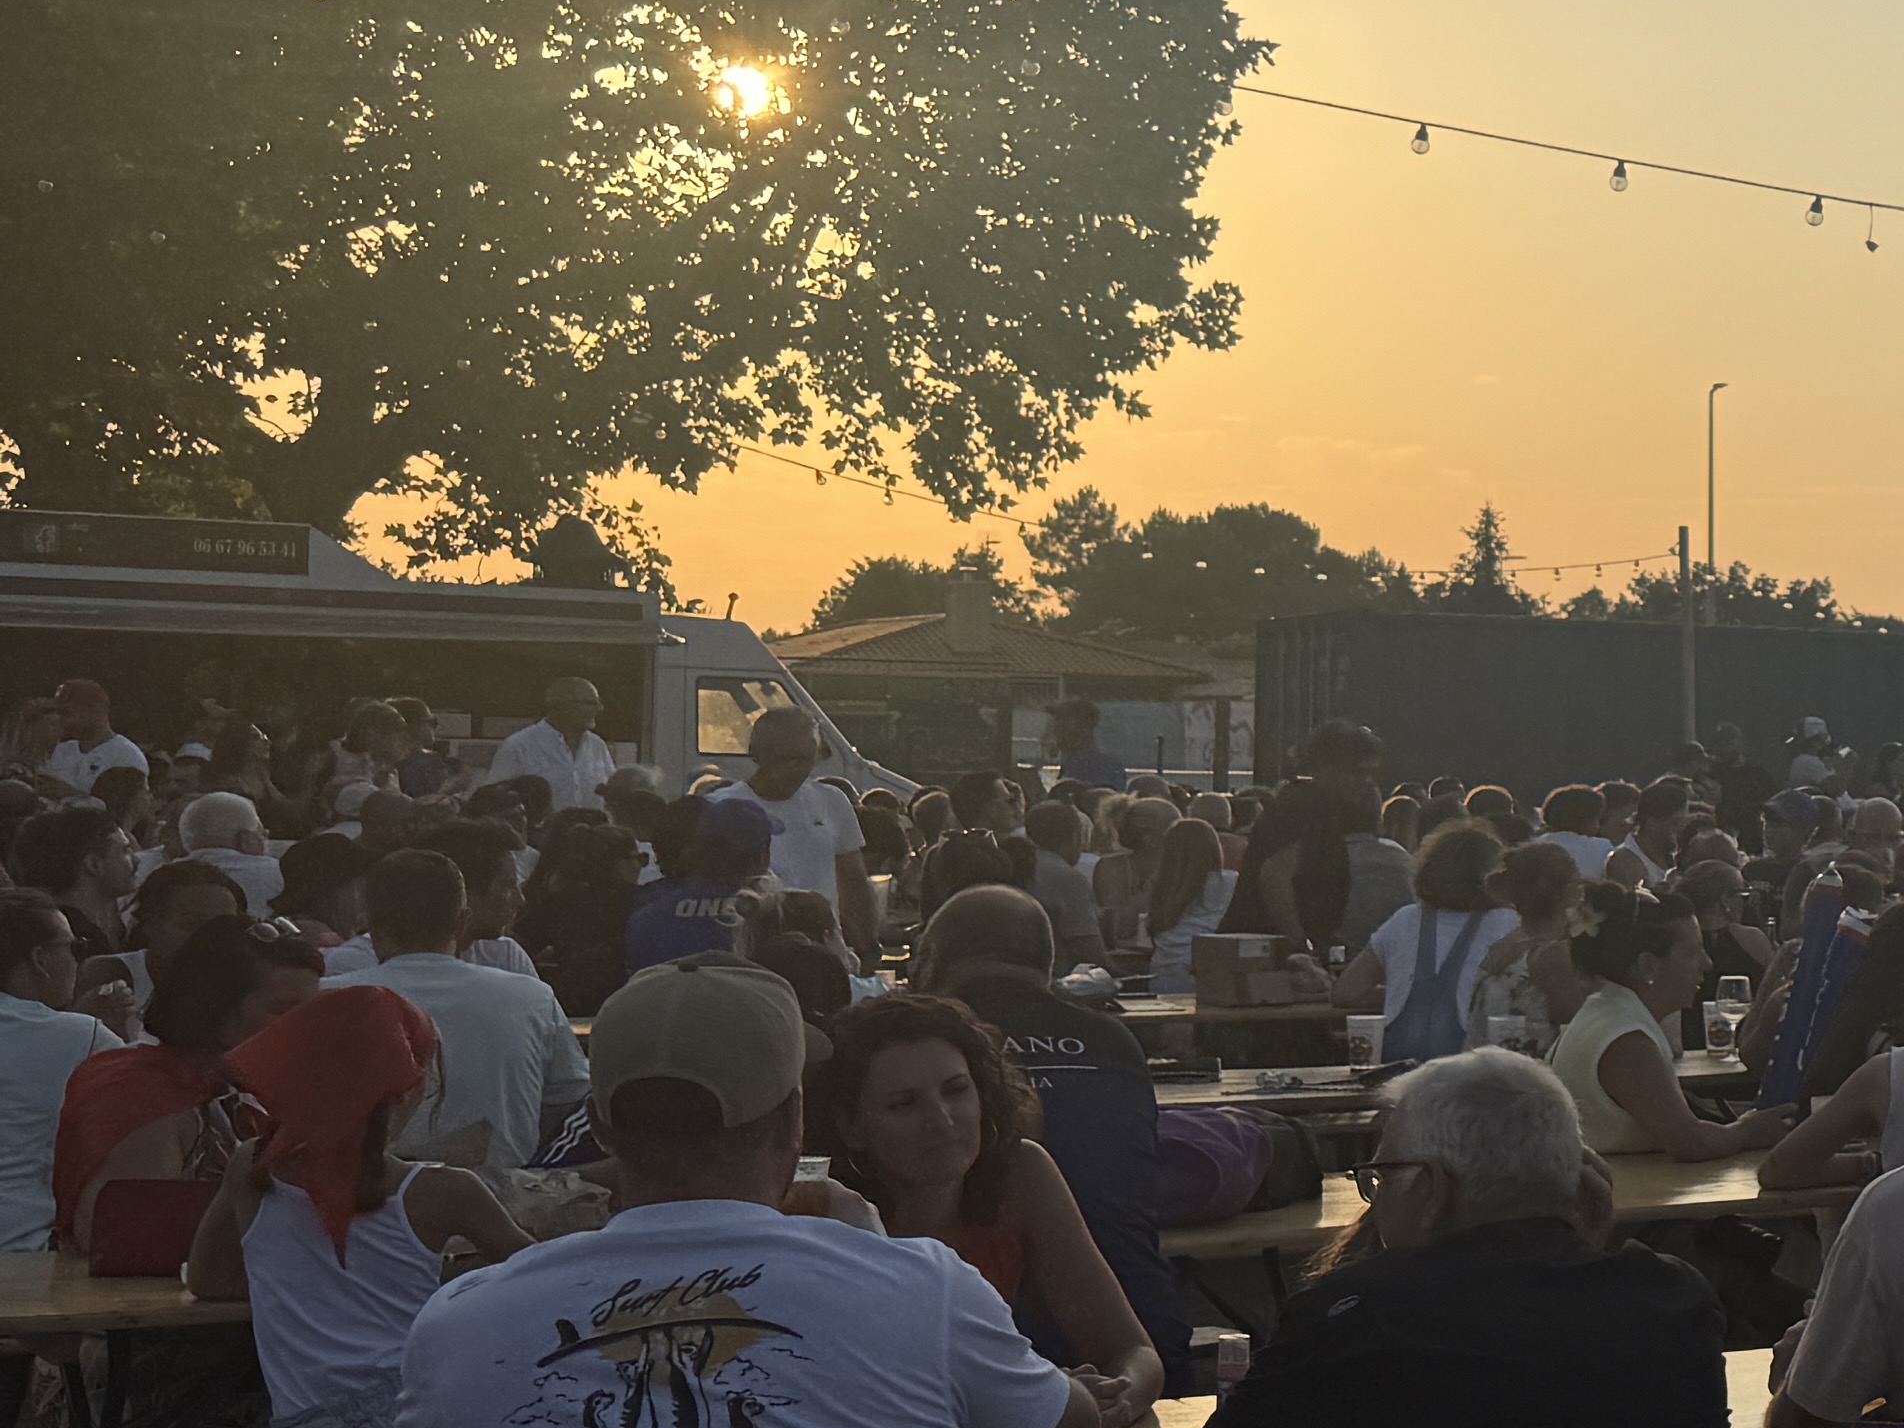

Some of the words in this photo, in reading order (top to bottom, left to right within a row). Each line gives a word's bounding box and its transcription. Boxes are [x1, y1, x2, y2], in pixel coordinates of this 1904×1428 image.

[1001, 1036, 1085, 1054] ANO
[590, 1277, 684, 1328] Surf
[679, 1263, 765, 1306] Club
